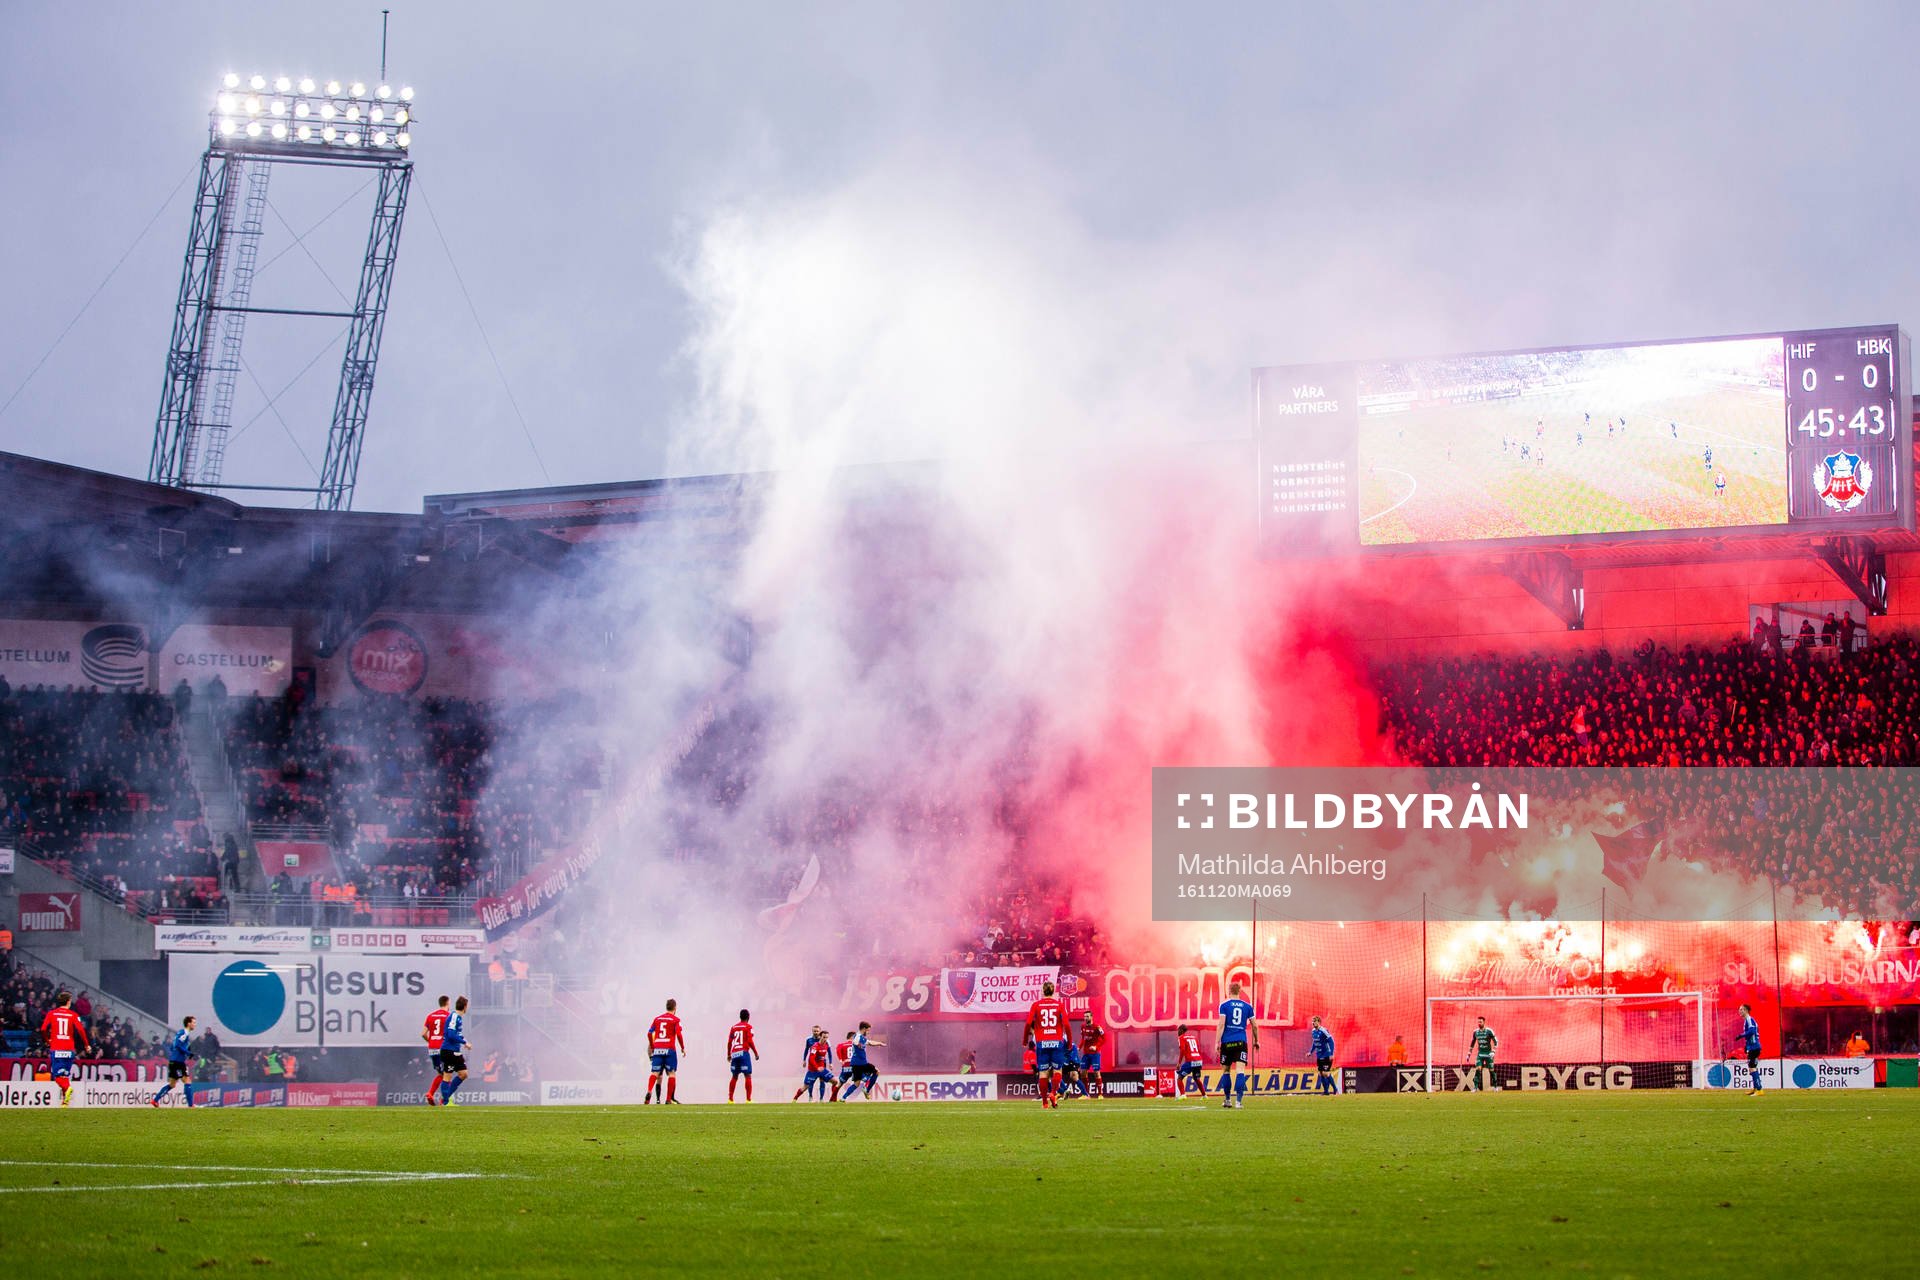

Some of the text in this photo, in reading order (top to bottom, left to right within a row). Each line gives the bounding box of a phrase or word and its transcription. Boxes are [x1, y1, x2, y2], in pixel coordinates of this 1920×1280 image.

[1791, 339, 1890, 359] HIF HBK
[1802, 368, 1817, 391] 0
[1863, 364, 1878, 388] 0
[1292, 384, 1325, 399] VÅRA
[1279, 400, 1338, 415] PARTNERS
[1799, 405, 1885, 438] 45:43
[1273, 459, 1346, 472] NORDSTRÖMS
[174, 653, 273, 667] CASTELLUM
[21, 911, 65, 930] PUMA
[339, 936, 405, 945] CRAMO
[296, 964, 425, 995] Resurs
[981, 974, 1051, 988] COME THE
[838, 974, 934, 1012] 1985
[981, 990, 1017, 1003] FUCK
[1106, 965, 1221, 1025] SÖDRA
[296, 1001, 389, 1033] Bank
[1040, 1009, 1058, 1027] 35
[1232, 1007, 1243, 1026] 9
[57, 1018, 69, 1036] 11
[434, 1019, 441, 1035] 3
[659, 1022, 667, 1038] 5
[734, 1030, 744, 1045] 21
[1187, 1039, 1199, 1052] 14
[1733, 1065, 1775, 1076] Reurs
[1819, 1064, 1860, 1076] Resurs
[1453, 1065, 1633, 1091] XL-BYGG
[1733, 1077, 1753, 1088] Ban
[1819, 1077, 1848, 1088] Bank
[1106, 1082, 1138, 1094] PUMA
[87, 1088, 120, 1105] thorn
[385, 1092, 442, 1104] FOREVR
[449, 1091, 487, 1103] ASTER
[489, 1091, 521, 1102] PUMA
